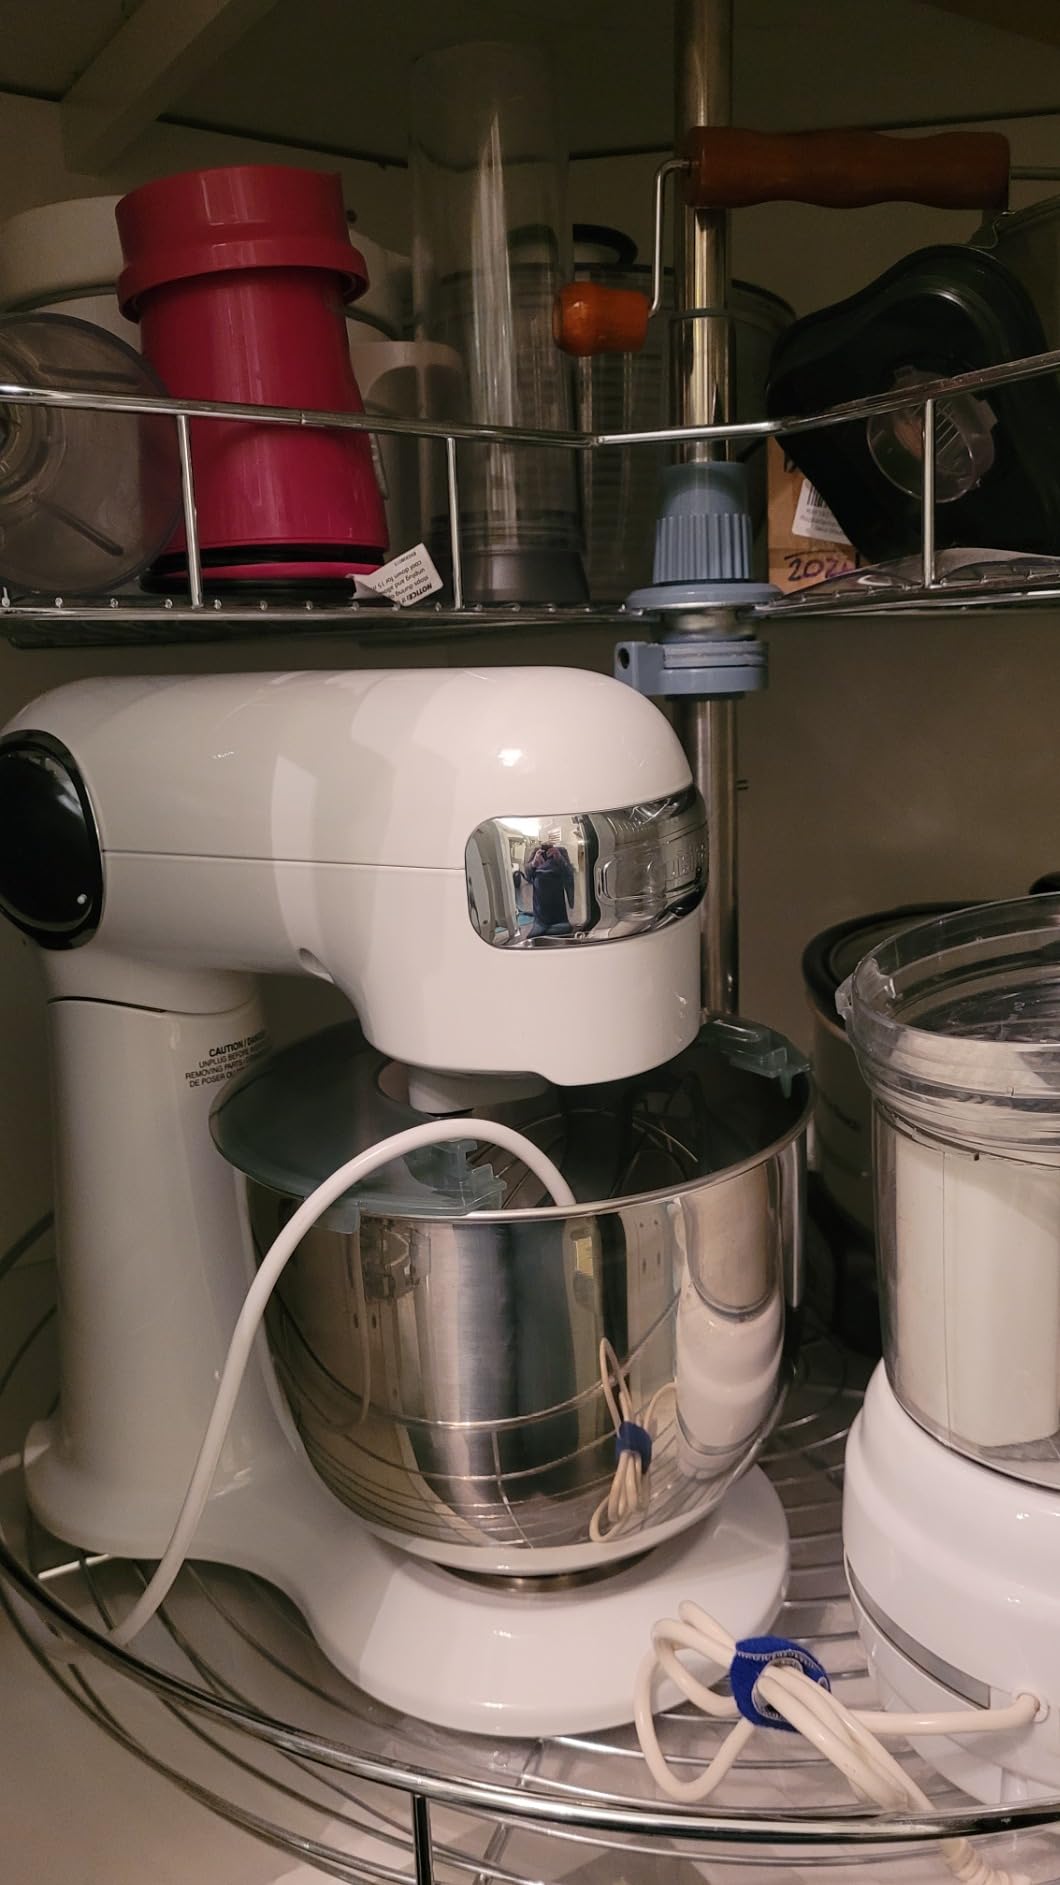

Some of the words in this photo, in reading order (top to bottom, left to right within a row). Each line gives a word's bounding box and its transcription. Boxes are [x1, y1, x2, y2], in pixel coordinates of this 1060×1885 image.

[386, 576, 394, 584] for
[405, 567, 426, 581] unplug
[406, 582, 433, 601] NOTICE:
[208, 1039, 243, 1057] CAUTION
[198, 1055, 227, 1069] UNPLUG
[185, 1065, 223, 1080] REMOVING
[189, 1078, 200, 1088] DE
[201, 1073, 226, 1085] POSER
